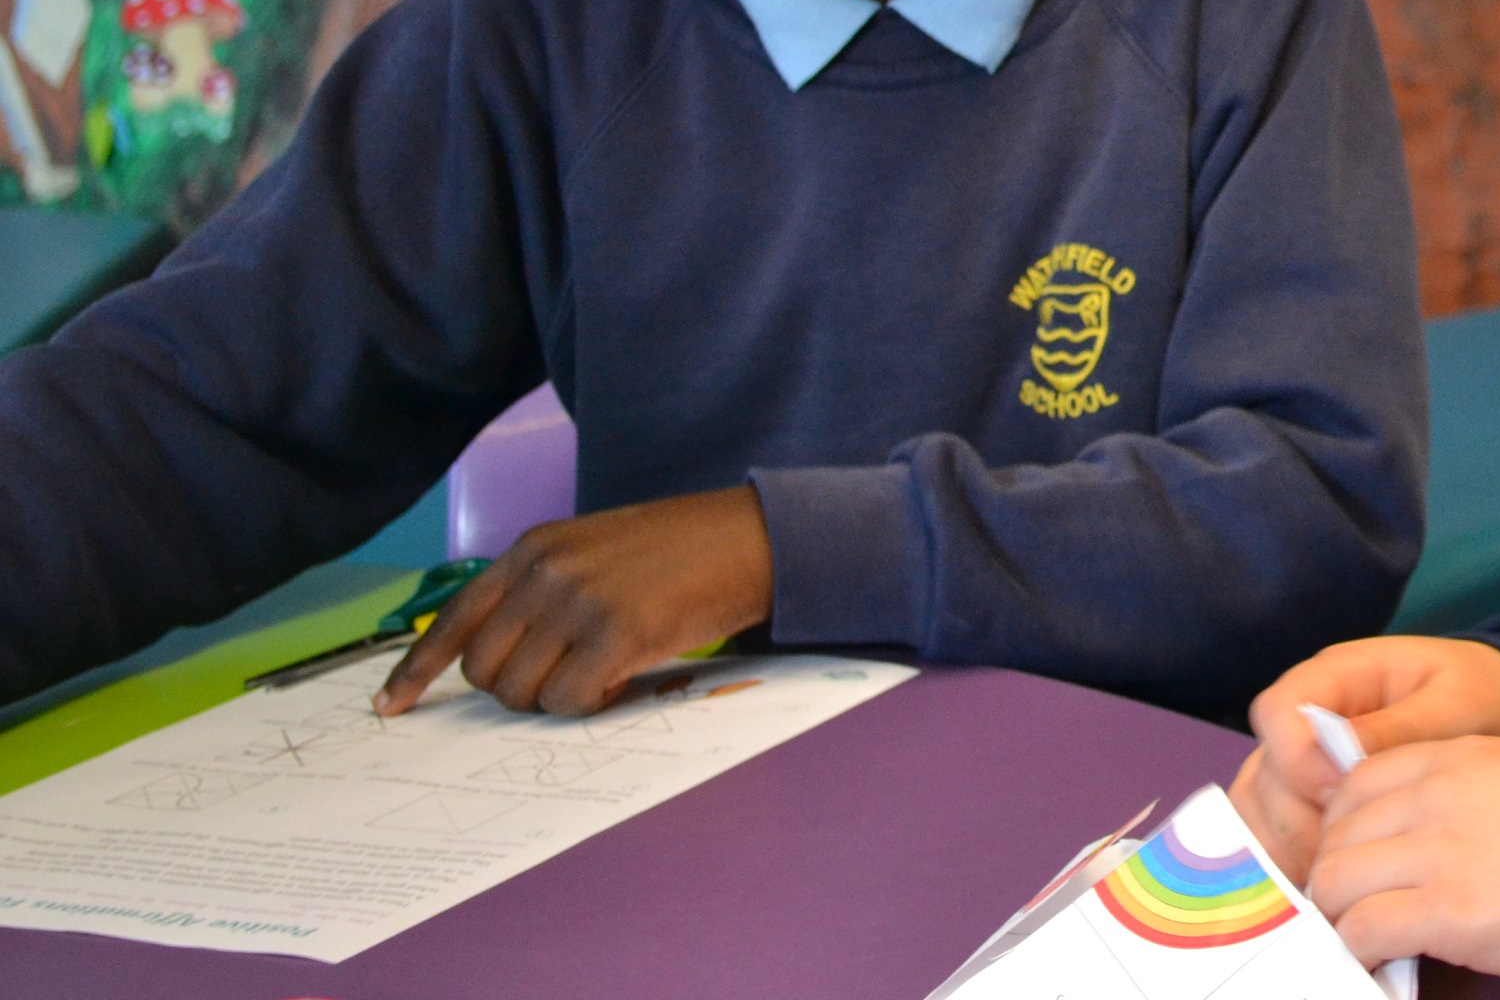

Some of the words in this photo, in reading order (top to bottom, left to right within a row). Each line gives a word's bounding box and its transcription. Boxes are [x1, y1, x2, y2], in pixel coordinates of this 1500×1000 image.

[1019, 379, 1119, 419] SCHOOL
[29, 898, 206, 928] Affirmations
[207, 917, 318, 938] Positive
